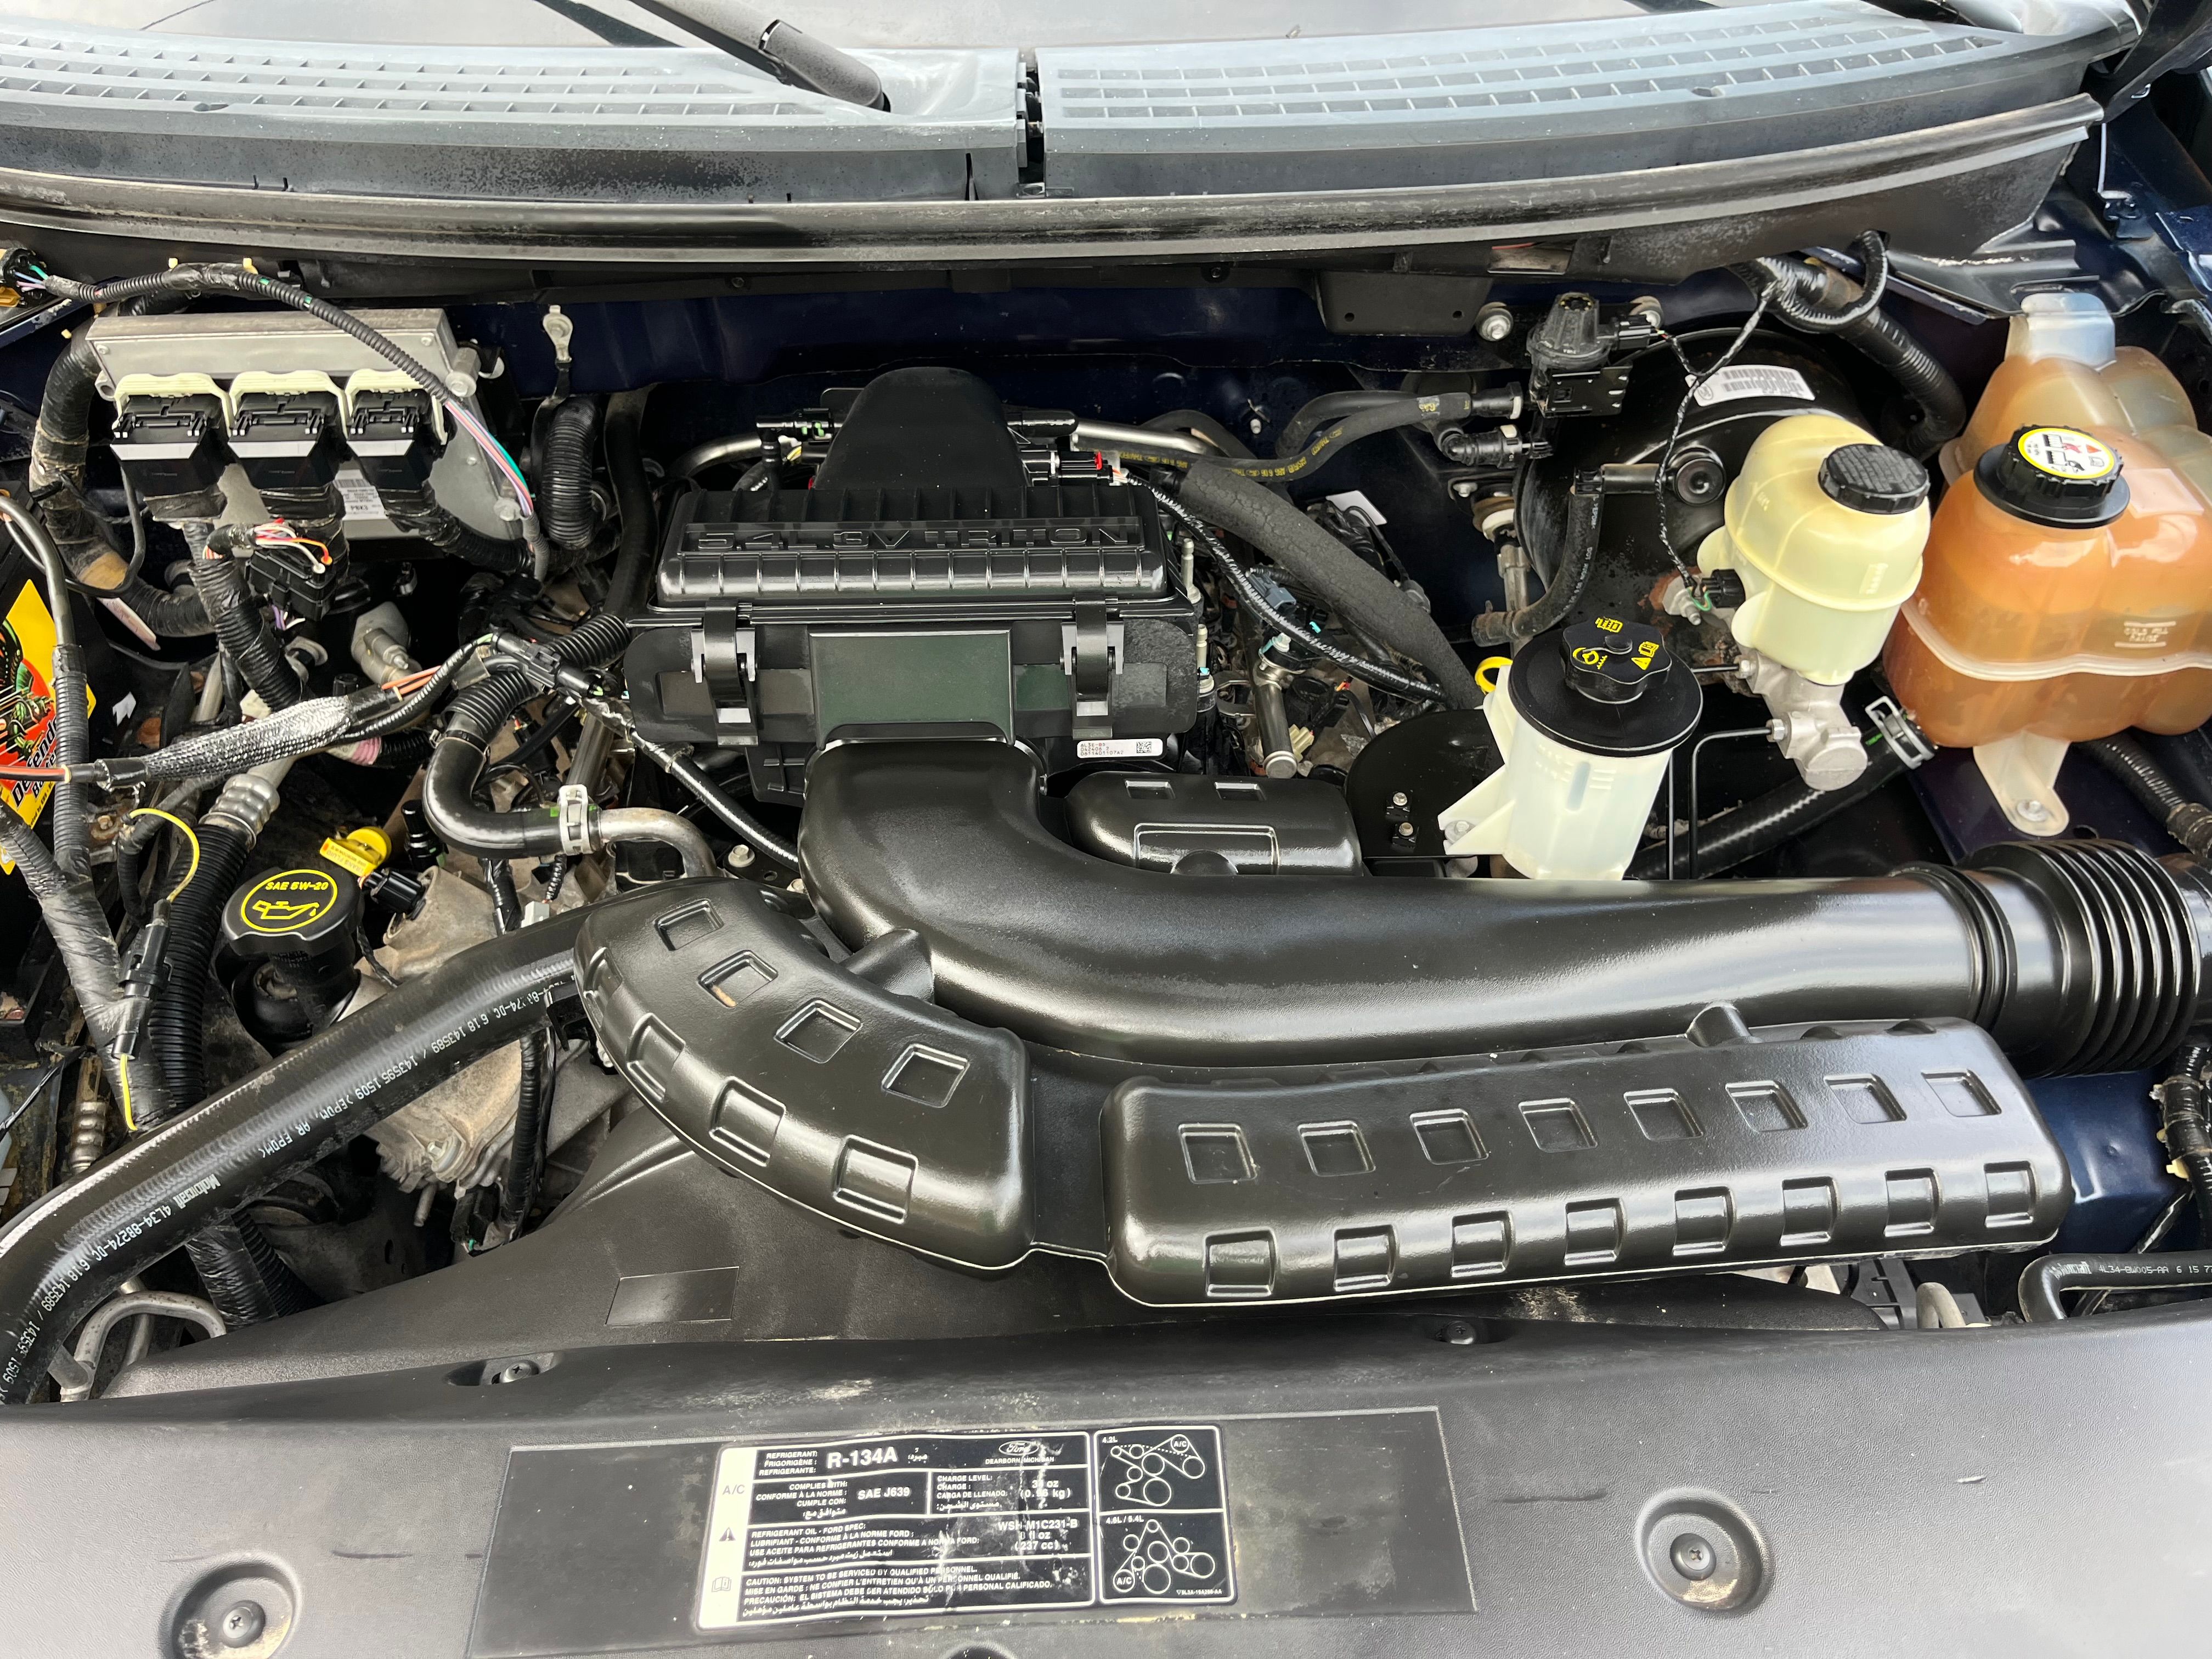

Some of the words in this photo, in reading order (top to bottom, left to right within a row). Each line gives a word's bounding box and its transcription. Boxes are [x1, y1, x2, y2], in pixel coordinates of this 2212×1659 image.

[698, 530, 817, 551] 5.4L
[832, 529, 910, 548] 3V
[924, 528, 1128, 547] TRITON
[265, 881, 291, 891] SAE
[291, 881, 329, 891] 5W-20
[467, 1018, 481, 1032] 18
[481, 1013, 489, 1025] 6
[431, 1026, 466, 1054] 143589
[382, 1055, 418, 1084] 143595
[355, 1077, 382, 1100] 1509
[295, 1121, 311, 1137] AR
[172, 1173, 221, 1210] Motorcraft
[91, 1204, 172, 1262] 4L34-8B274-DC
[81, 1259, 91, 1271] 6
[2098, 1264, 2169, 1274] 4L34-8W005-AA
[2176, 1265, 2182, 1273] 6
[2188, 1265, 2199, 1273] 15
[69, 1266, 83, 1282] 18
[41, 1277, 71, 1312] 143589
[2, 1356, 20, 1385] 1509
[766, 1451, 818, 1459] REFRIGERANT:
[1006, 1442, 1031, 1454] Ford
[826, 1446, 898, 1469] R-134A
[759, 1467, 816, 1476] REFRIGERANTE:
[721, 1484, 746, 1495] A/C
[789, 1482, 826, 1491] COMPLIES
[857, 1488, 882, 1500] SAE
[884, 1487, 911, 1498] J639
[755, 1492, 797, 1501] CONFORME
[1105, 1516, 1122, 1524] 4.6L
[1127, 1515, 1144, 1523] 5.4L
[751, 1538, 793, 1547] LUBRIFIANT
[799, 1534, 841, 1544] CONFORME
[861, 1530, 887, 1538] NORME
[752, 1528, 803, 1538] REFRIGERANT
[823, 1526, 843, 1534] FORD
[844, 1523, 866, 1532] SPEC:
[749, 1548, 765, 1556] USE
[766, 1546, 793, 1556] ACEITE
[794, 1545, 815, 1554] PARA
[816, 1539, 876, 1551] REFRIGERANTES
[878, 1538, 920, 1547] CONFORME
[956, 1536, 980, 1544] FORD:
[746, 1577, 782, 1587] CAUTION:
[783, 1575, 814, 1584] SYSTEM
[839, 1568, 876, 1578] SERVICED
[889, 1567, 929, 1576] QUALIFIED
[1116, 1577, 1132, 1585] A/C
[745, 1587, 764, 1595] MISE
[765, 1586, 776, 1594] EN
[777, 1584, 804, 1593] GARDE
[821, 1579, 854, 1590] CONFIER
[855, 1577, 904, 1586] L'ENTRETIEN
[926, 1576, 936, 1584] UN
[810, 1590, 843, 1600] SISTEMA
[844, 1588, 865, 1596] DEBE
[883, 1586, 921, 1595] ATENDIDO
[963, 1582, 1004, 1591] PERSONAL
[1005, 1580, 1052, 1589] CALIFICADO.
